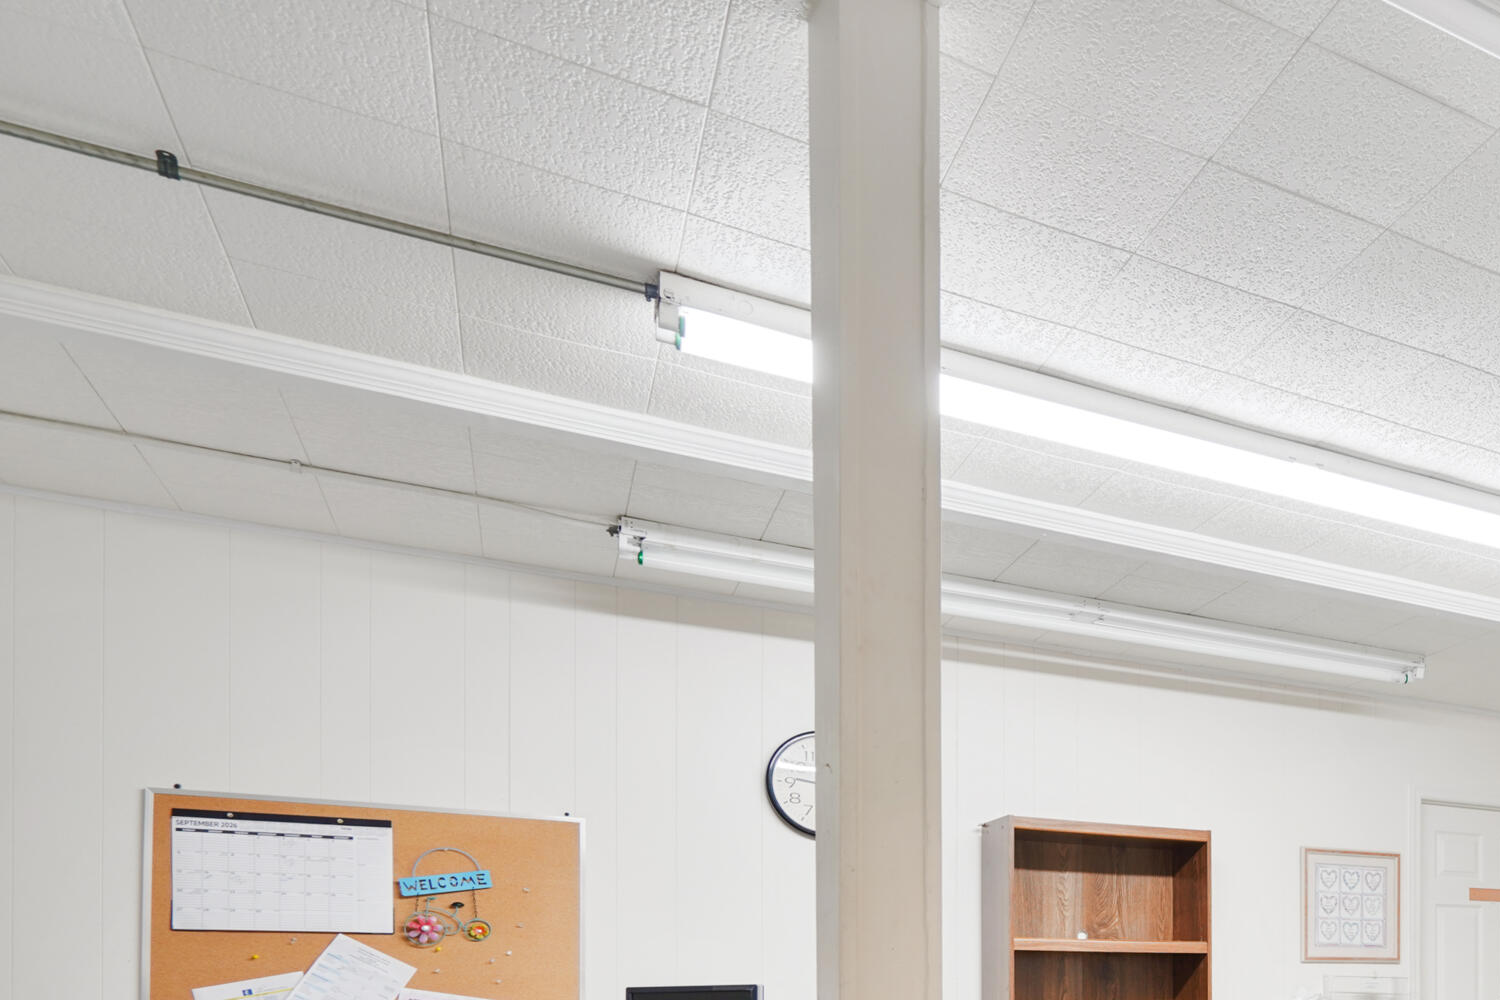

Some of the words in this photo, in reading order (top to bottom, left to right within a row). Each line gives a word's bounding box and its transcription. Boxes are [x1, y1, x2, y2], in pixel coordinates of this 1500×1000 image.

[804, 750, 815, 761] 11
[784, 776, 796, 788] 9
[789, 792, 801, 804] 8
[803, 804, 813, 817] 7
[176, 819, 219, 828] SEPTEMBER
[403, 873, 488, 891] WELCOME
